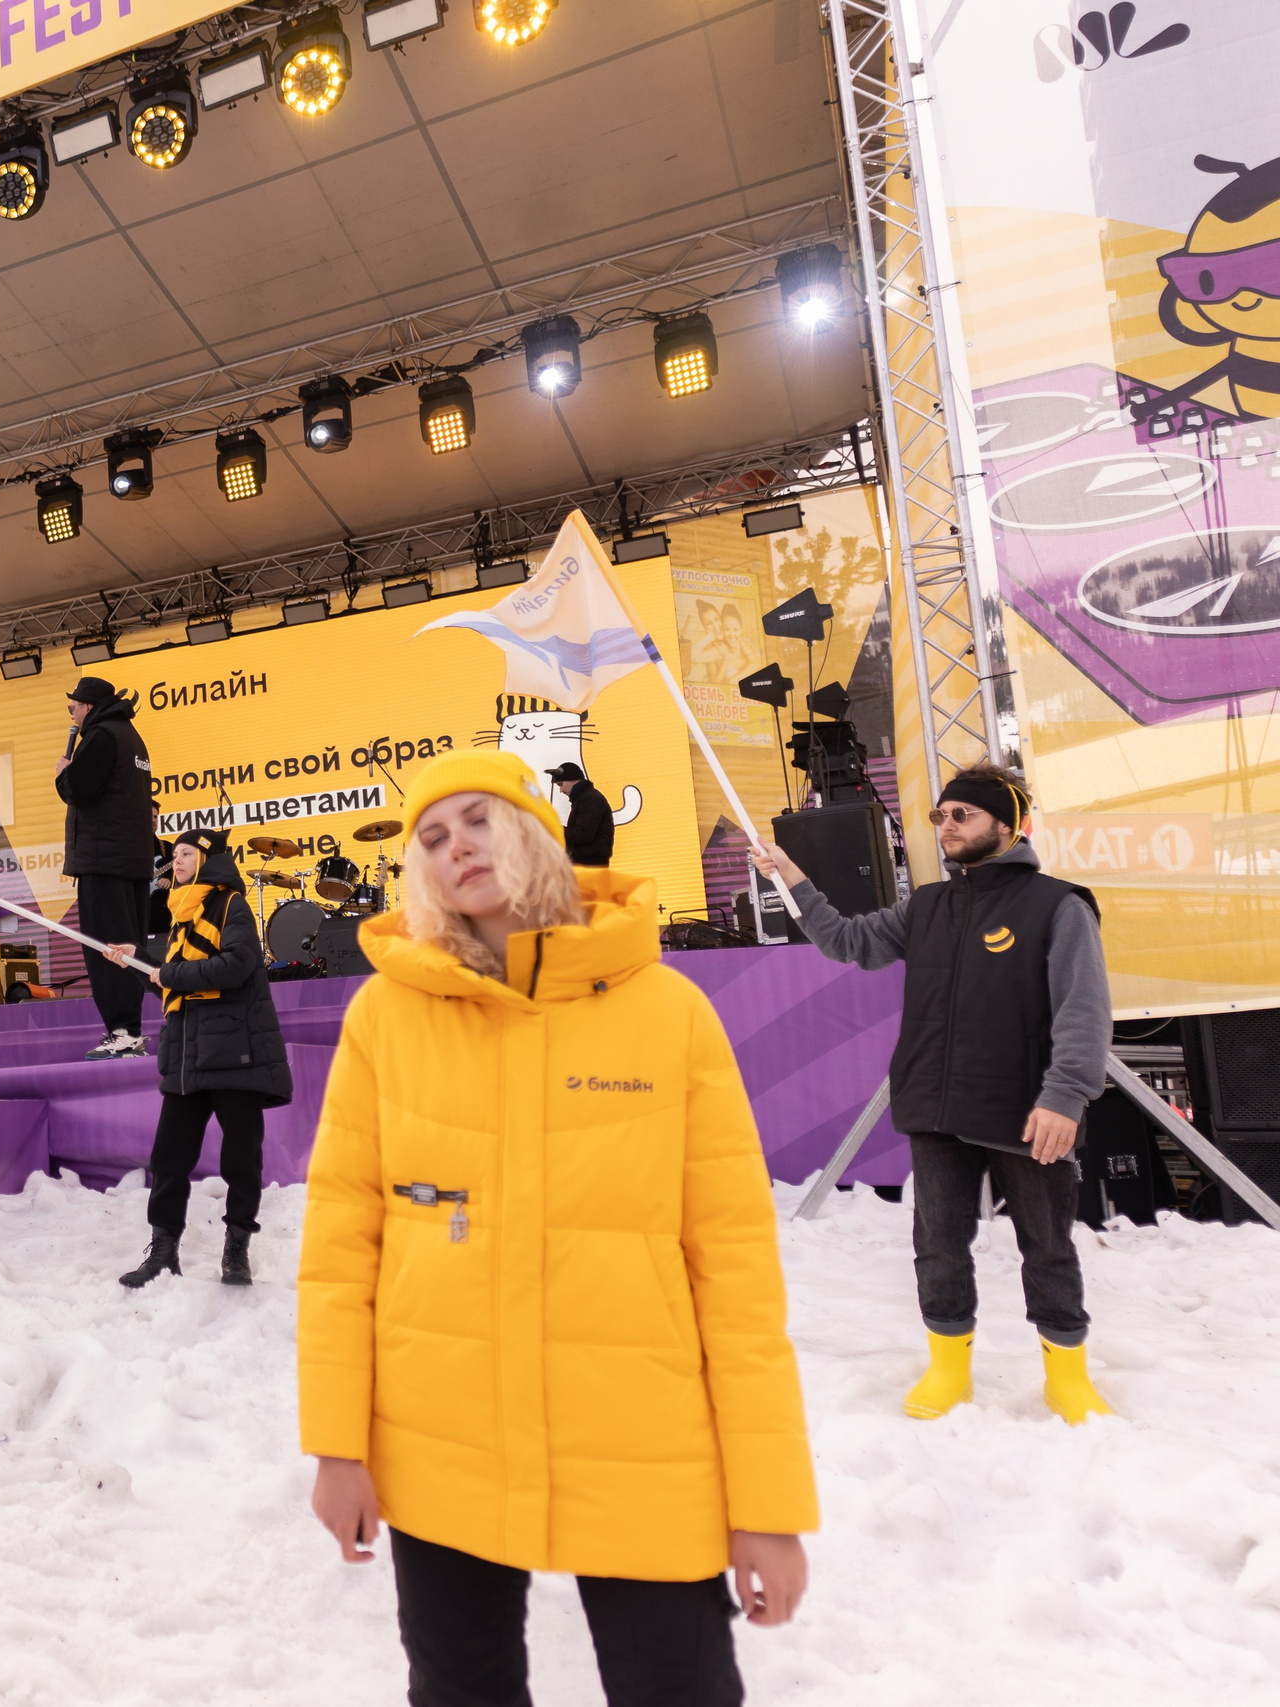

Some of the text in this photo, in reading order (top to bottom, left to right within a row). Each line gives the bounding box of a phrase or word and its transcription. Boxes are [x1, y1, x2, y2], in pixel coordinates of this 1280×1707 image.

[671, 569, 751, 587] РУГЛОСУТОЧНО
[779, 610, 806, 621] SHURE
[149, 669, 267, 711] билайн
[684, 685, 726, 703] ОСЕМЬ
[695, 703, 747, 720] НА ГОРЕ
[704, 721, 722, 731] 2300
[151, 736, 454, 797] ополни свой образ
[160, 786, 381, 834] кими цветами
[1043, 826, 1134, 871] ОКАТ
[587, 1077, 654, 1093] билайн
